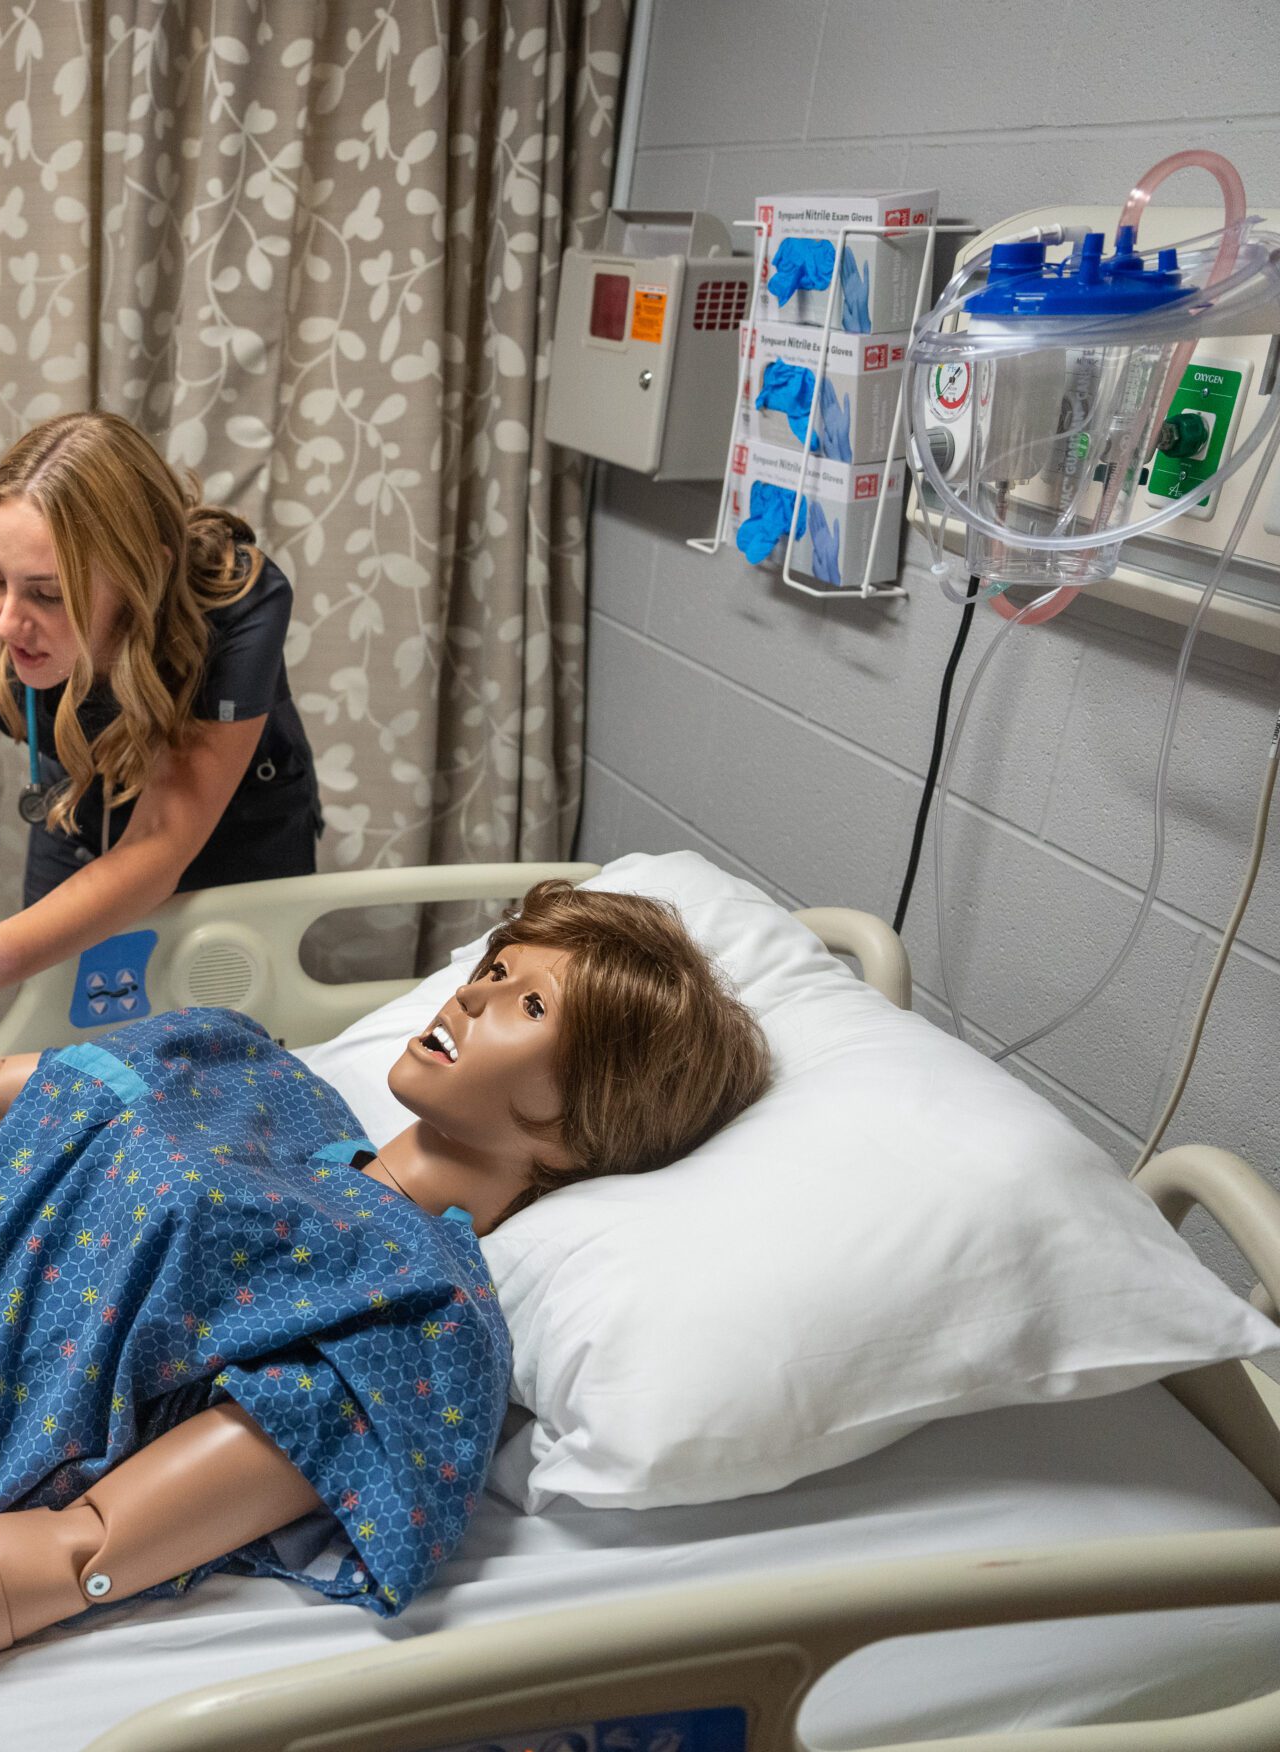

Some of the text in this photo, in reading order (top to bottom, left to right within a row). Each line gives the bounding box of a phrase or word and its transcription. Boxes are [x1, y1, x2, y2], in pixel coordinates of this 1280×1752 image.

[805, 208, 831, 220] Nitrile
[832, 212, 850, 221] Exam
[851, 212, 873, 222] Gloves
[912, 213, 925, 225] S
[788, 336, 812, 350] Nitrile
[831, 345, 853, 357] Gloves
[891, 347, 904, 362] M
[1194, 372, 1224, 385] OXYGEN
[822, 472, 844, 485] Gloves
